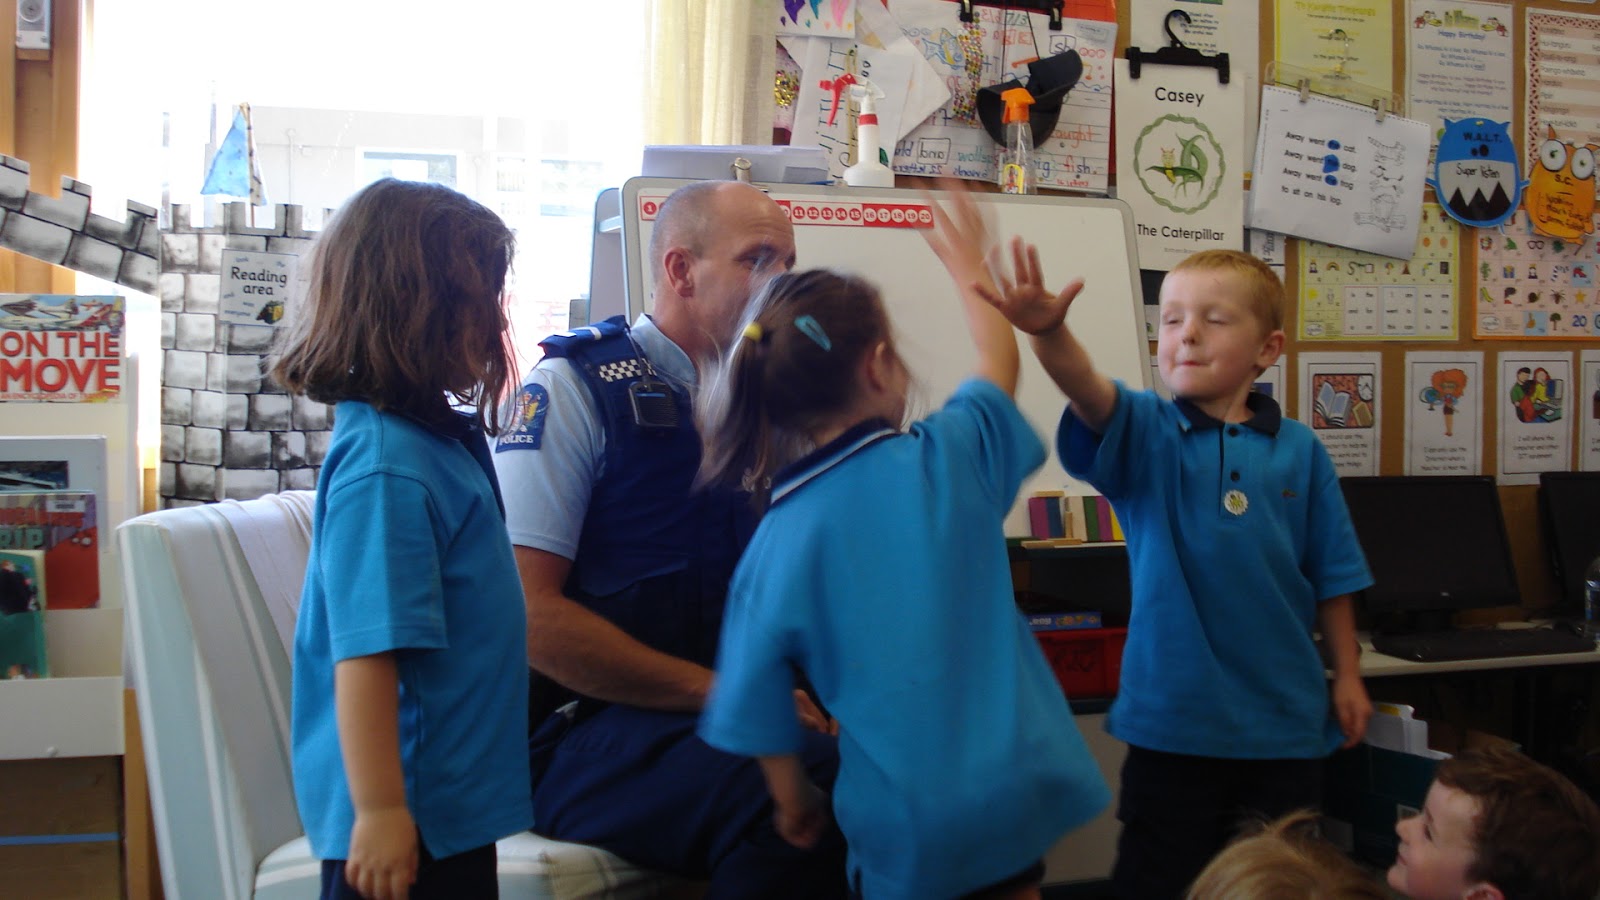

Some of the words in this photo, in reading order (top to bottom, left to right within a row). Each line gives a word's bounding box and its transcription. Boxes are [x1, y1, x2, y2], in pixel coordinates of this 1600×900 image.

[1155, 87, 1204, 107] Casey
[1052, 125, 1095, 148] aught
[1286, 132, 1305, 143] Away
[1309, 138, 1325, 146] went
[1284, 150, 1303, 161] Away
[1307, 155, 1324, 164] went
[1283, 168, 1301, 179] Away
[1305, 173, 1322, 181] went
[1137, 224, 1157, 237] The
[1161, 226, 1225, 241] Caterpillar
[231, 266, 288, 288] Reading
[243, 285, 275, 295] area
[1572, 314, 1588, 327] 20
[0, 331, 48, 357] ON
[57, 331, 120, 358] THE
[0, 358, 120, 392] MOVE
[499, 435, 534, 445] POLICE
